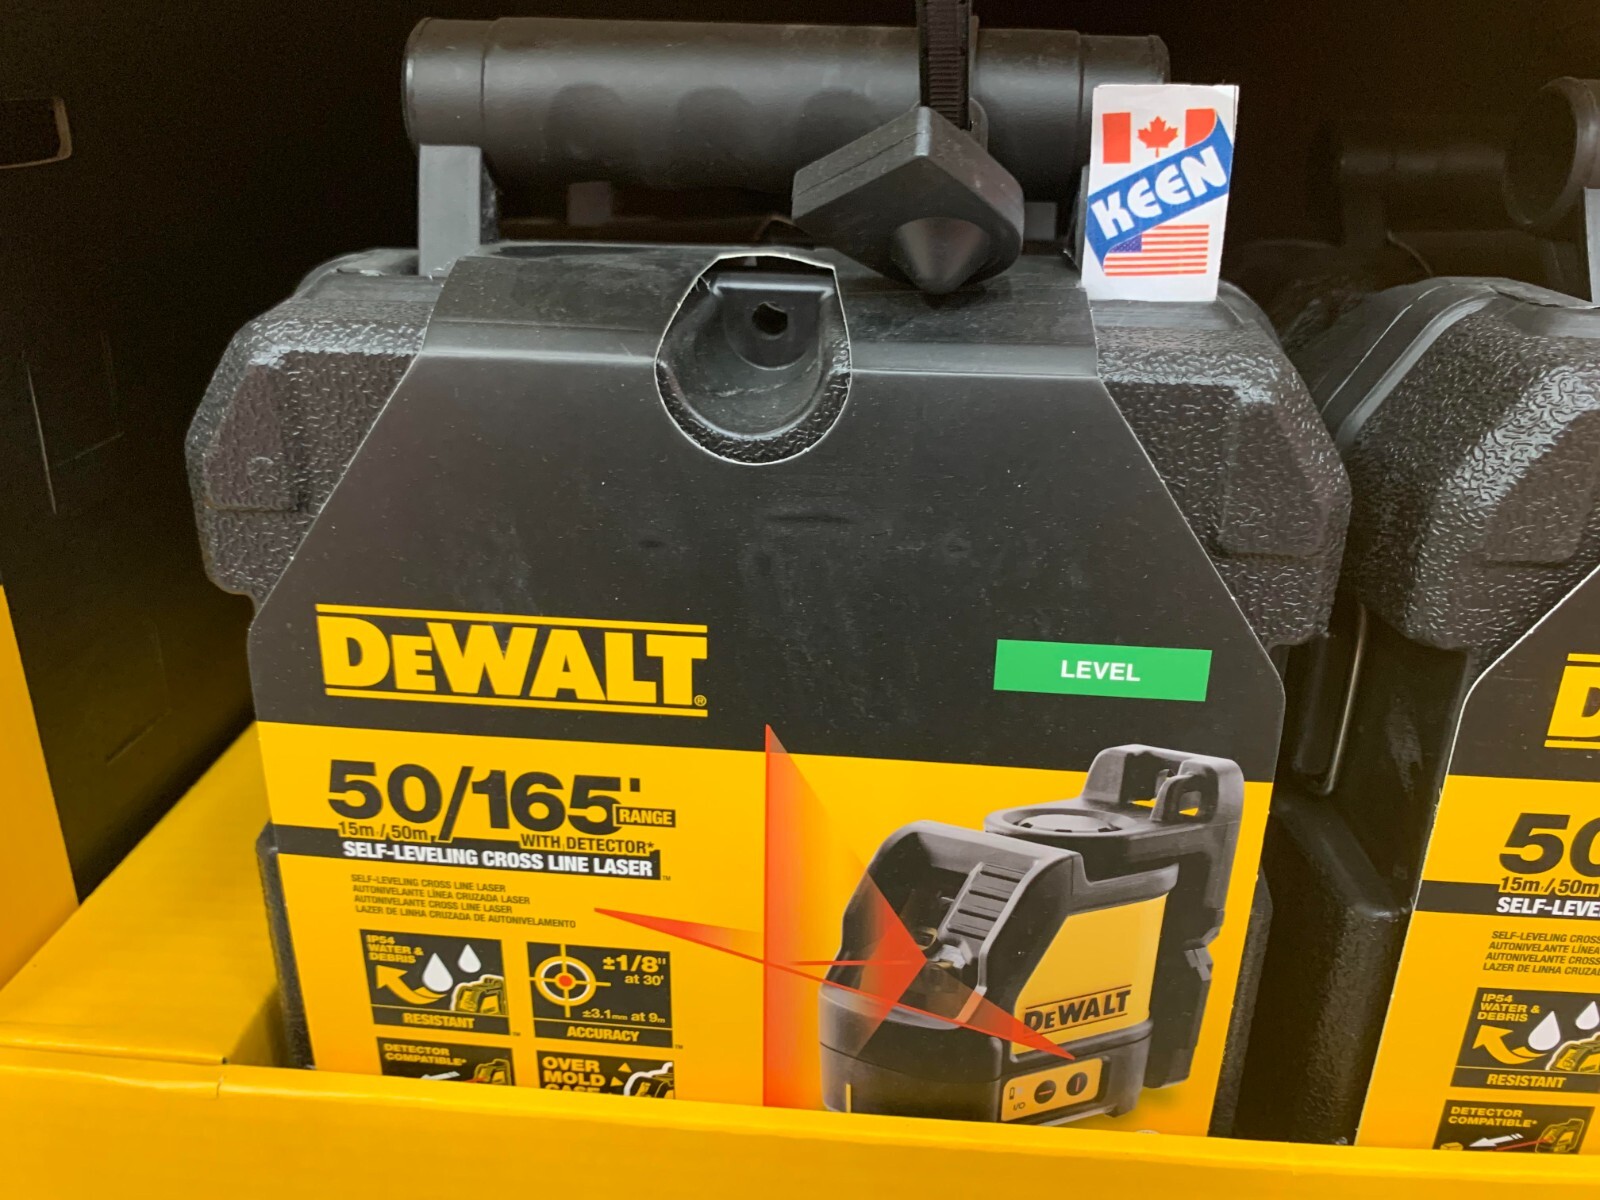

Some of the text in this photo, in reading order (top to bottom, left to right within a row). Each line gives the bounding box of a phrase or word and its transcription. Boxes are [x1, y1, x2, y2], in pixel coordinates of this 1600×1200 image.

[1090, 145, 1228, 240] KEEN
[1060, 659, 1141, 682] LEVEL
[618, 808, 673, 826] RANGE
[338, 820, 374, 837] 15m
[391, 824, 428, 841] 50m
[520, 833, 560, 849] WITH
[342, 840, 478, 865] SELF-LEVELING
[482, 850, 544, 870] CROSS
[547, 854, 589, 873] LINE
[593, 858, 653, 877] LASER
[351, 873, 506, 892] SELF-LEVELING CROSS LINE LASER
[1501, 876, 1541, 893] 15m
[1557, 878, 1600, 896] 50m
[353, 884, 425, 897] AUTONIVELANTE
[455, 892, 498, 903] CRUZADA
[501, 894, 531, 905] LASER
[354, 895, 513, 914] AUTONIVELANTE CROSS LINE LASER
[1495, 896, 1600, 918] SELF-LEVE
[355, 904, 576, 928] LAZER DE LINHA CRUZADA DE AUTONIVELAMENTO
[365, 934, 396, 945] IP54
[1491, 930, 1568, 943] SELF-LEVELING
[367, 943, 424, 956] WATER &
[1488, 941, 1570, 954] AUTONIVELANTE
[369, 952, 417, 964] DEBRIS
[1485, 952, 1567, 964] AUTONIVELANTE
[1483, 962, 1515, 972] LAZER
[1516, 963, 1531, 973] DE
[1532, 965, 1562, 975] LINHA
[624, 974, 640, 985] at
[1481, 993, 1514, 1003] IP54
[1024, 989, 1132, 1032] DEWALT
[1480, 1002, 1541, 1014] WATER &
[402, 1013, 475, 1029] RESISTANT
[631, 1012, 646, 1022] at
[648, 1012, 666, 1024] 9m
[1477, 1011, 1529, 1022] DEBRIS
[566, 1026, 640, 1042] ACCURACY
[383, 1043, 450, 1056] DETECTOR
[542, 1056, 601, 1073] OVER
[543, 1070, 606, 1087] MOLD
[1486, 1073, 1567, 1089] RESISTANT
[1450, 1106, 1523, 1118] DETECTOR
